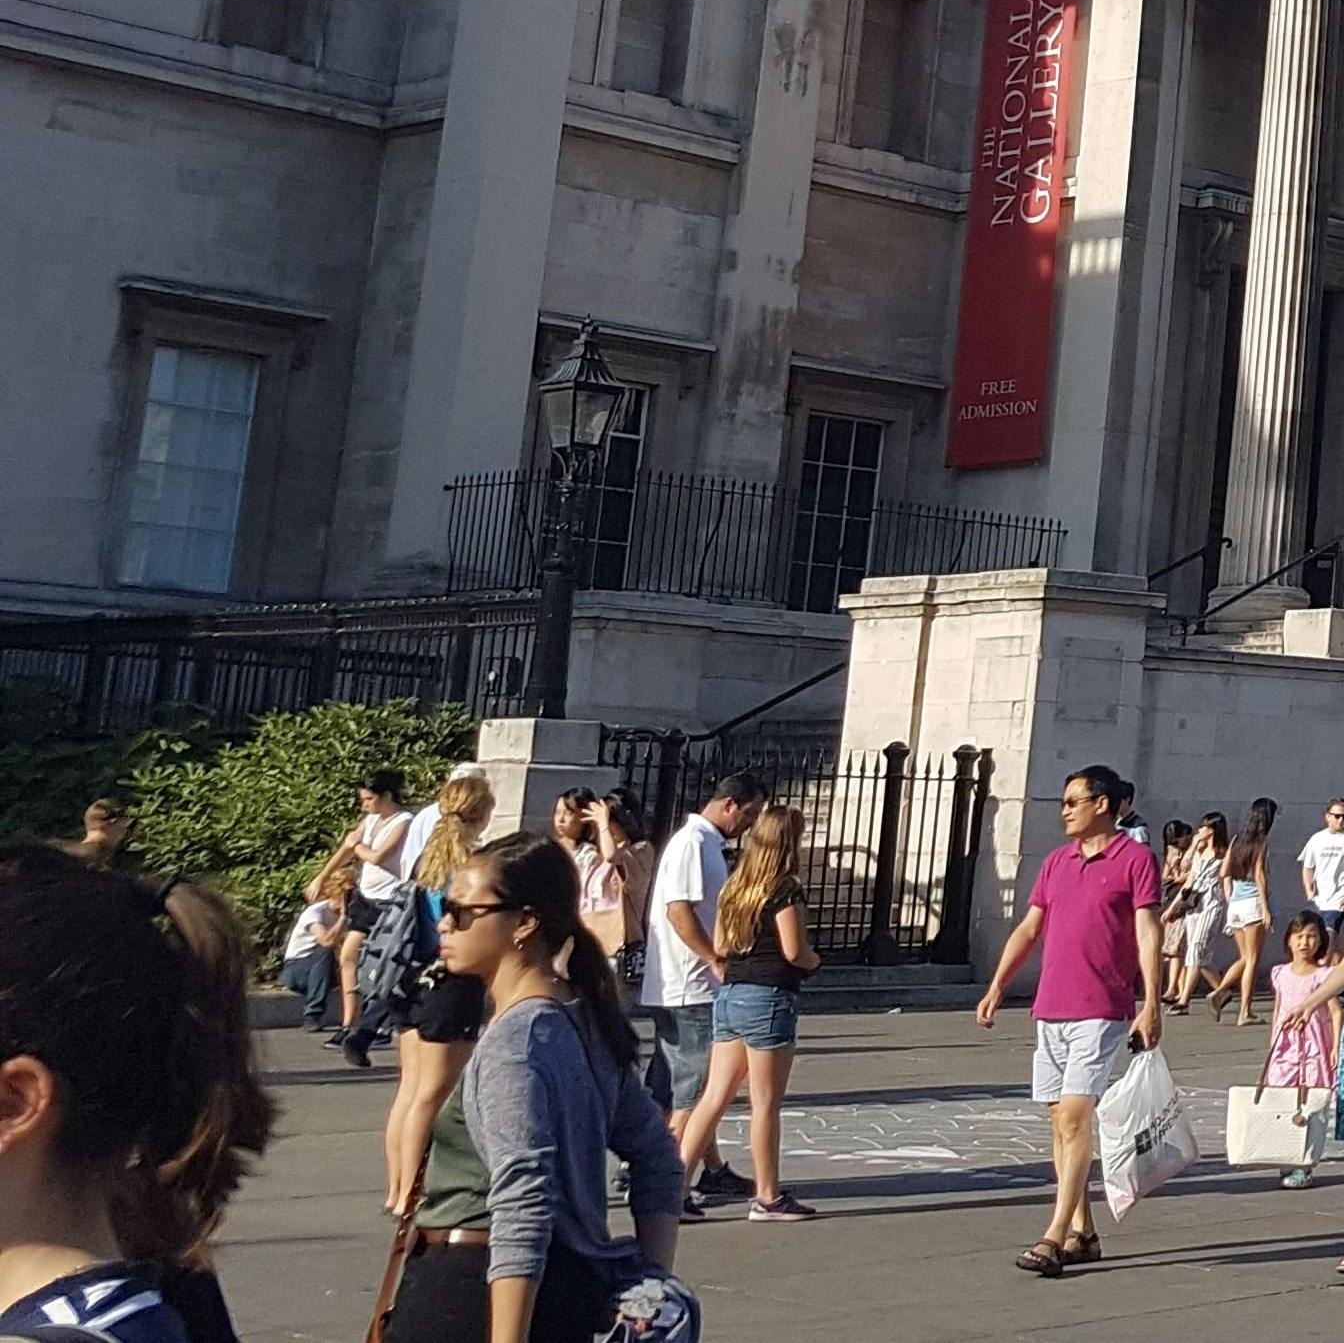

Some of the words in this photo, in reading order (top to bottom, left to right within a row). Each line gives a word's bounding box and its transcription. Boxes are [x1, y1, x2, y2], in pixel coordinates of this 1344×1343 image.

[981, 126, 997, 171] THE
[981, 379, 1017, 396] FREE
[959, 399, 1038, 421] ADMISSION
